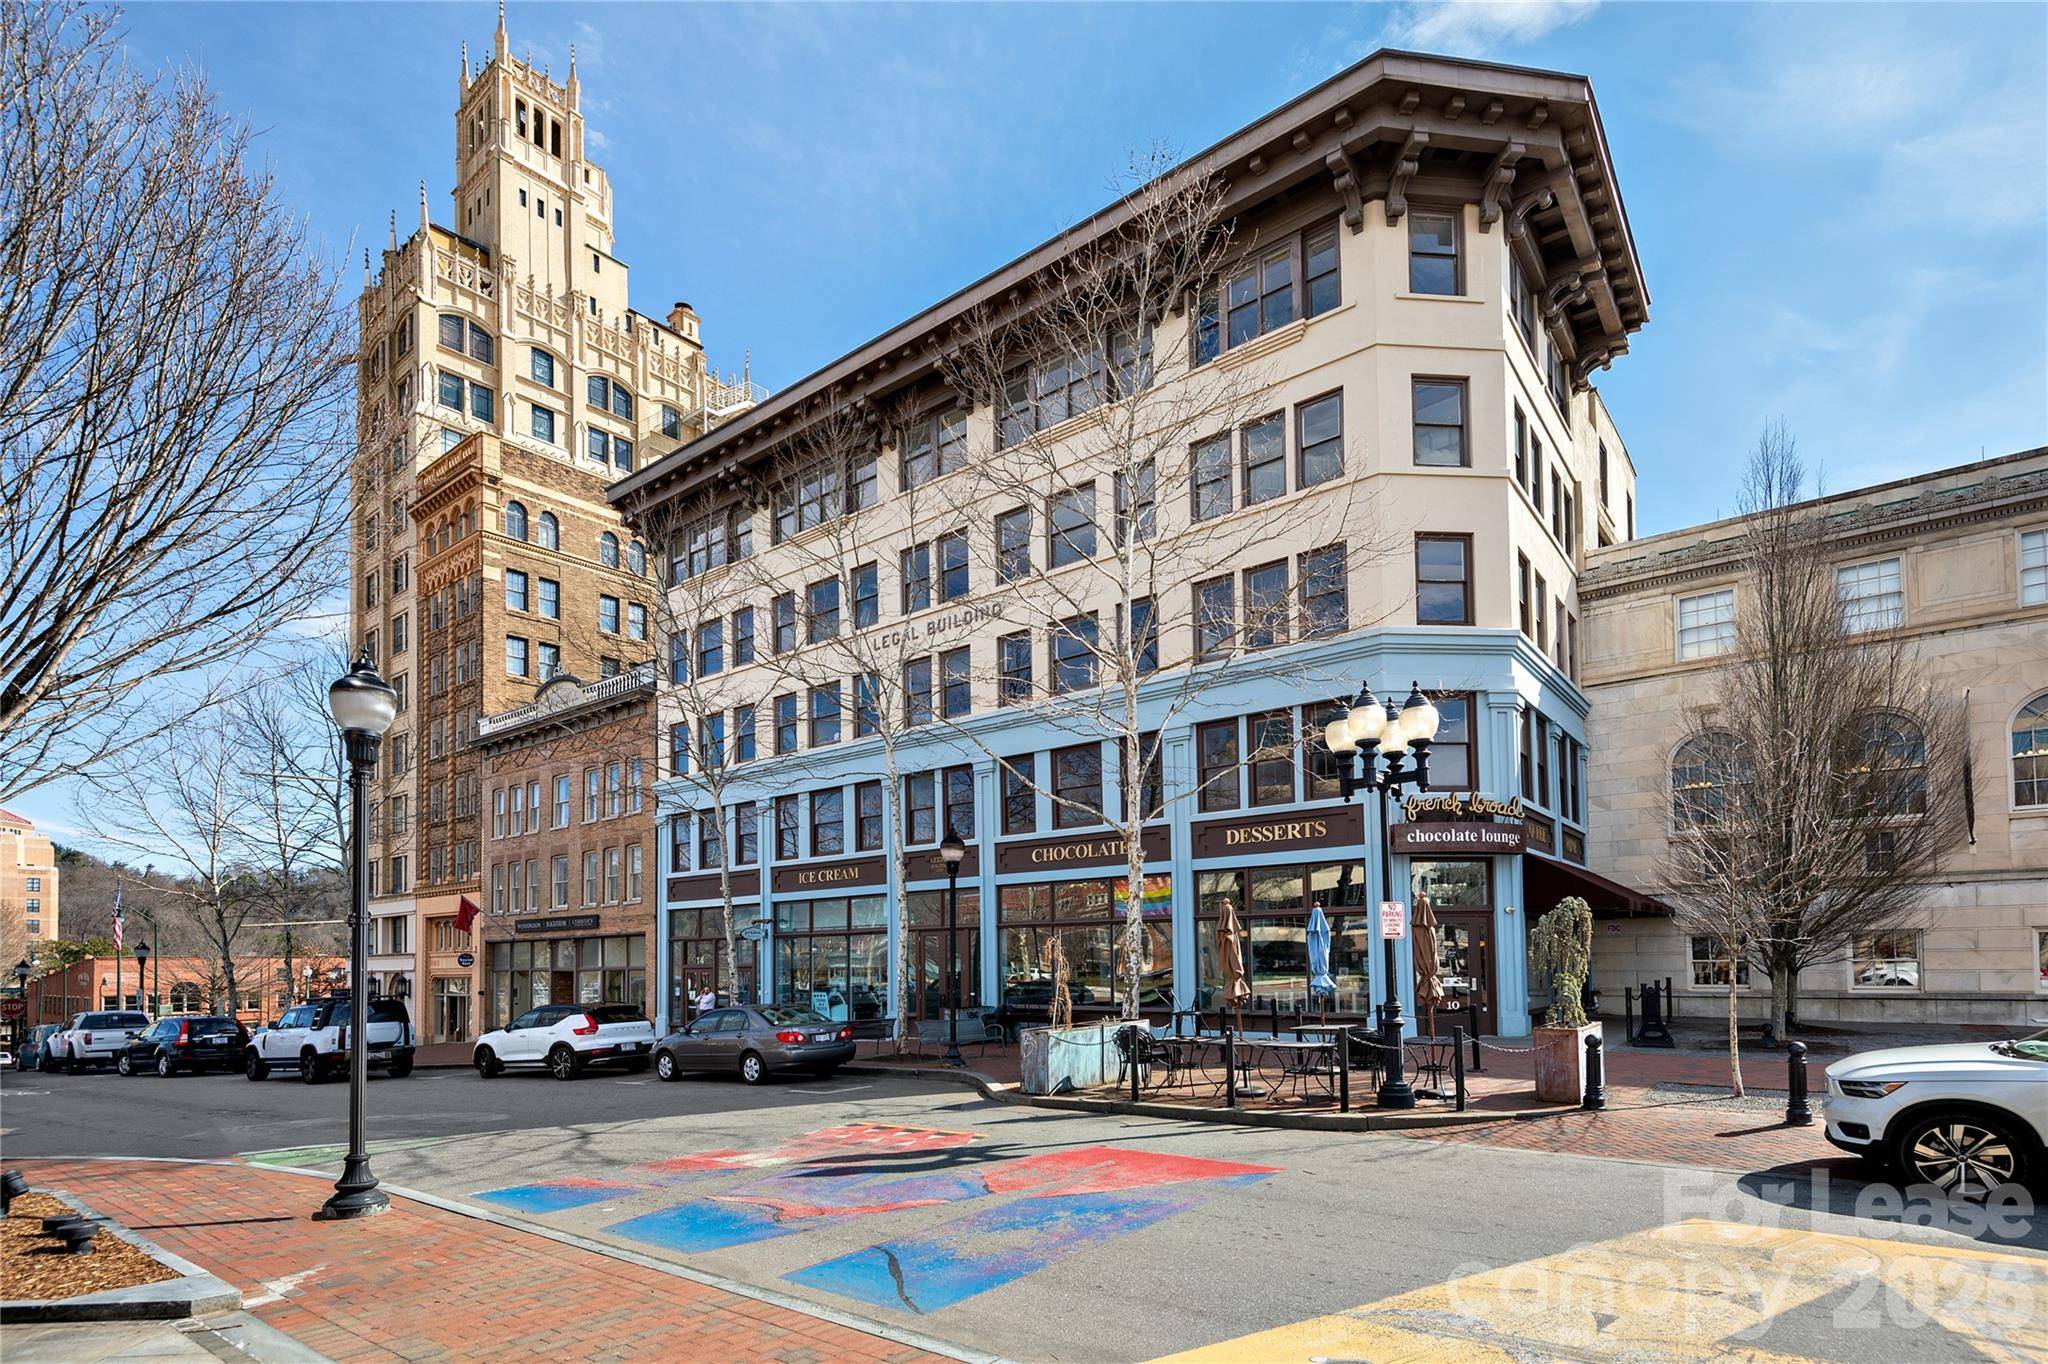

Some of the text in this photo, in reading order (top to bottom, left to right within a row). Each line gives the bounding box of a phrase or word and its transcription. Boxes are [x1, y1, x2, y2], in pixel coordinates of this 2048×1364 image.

[926, 601, 1003, 636] BUILDING
[1402, 791, 1525, 821] french broad
[1225, 820, 1327, 846] DESSERTS
[1407, 828, 1521, 847] chocolate lounge
[1031, 840, 1130, 863] CHOCOLATE
[798, 867, 859, 884] ICE CREAM
[1388, 903, 1397, 911] NO
[1, 1003, 24, 1011] STOP
[1446, 1001, 1460, 1010] 10
